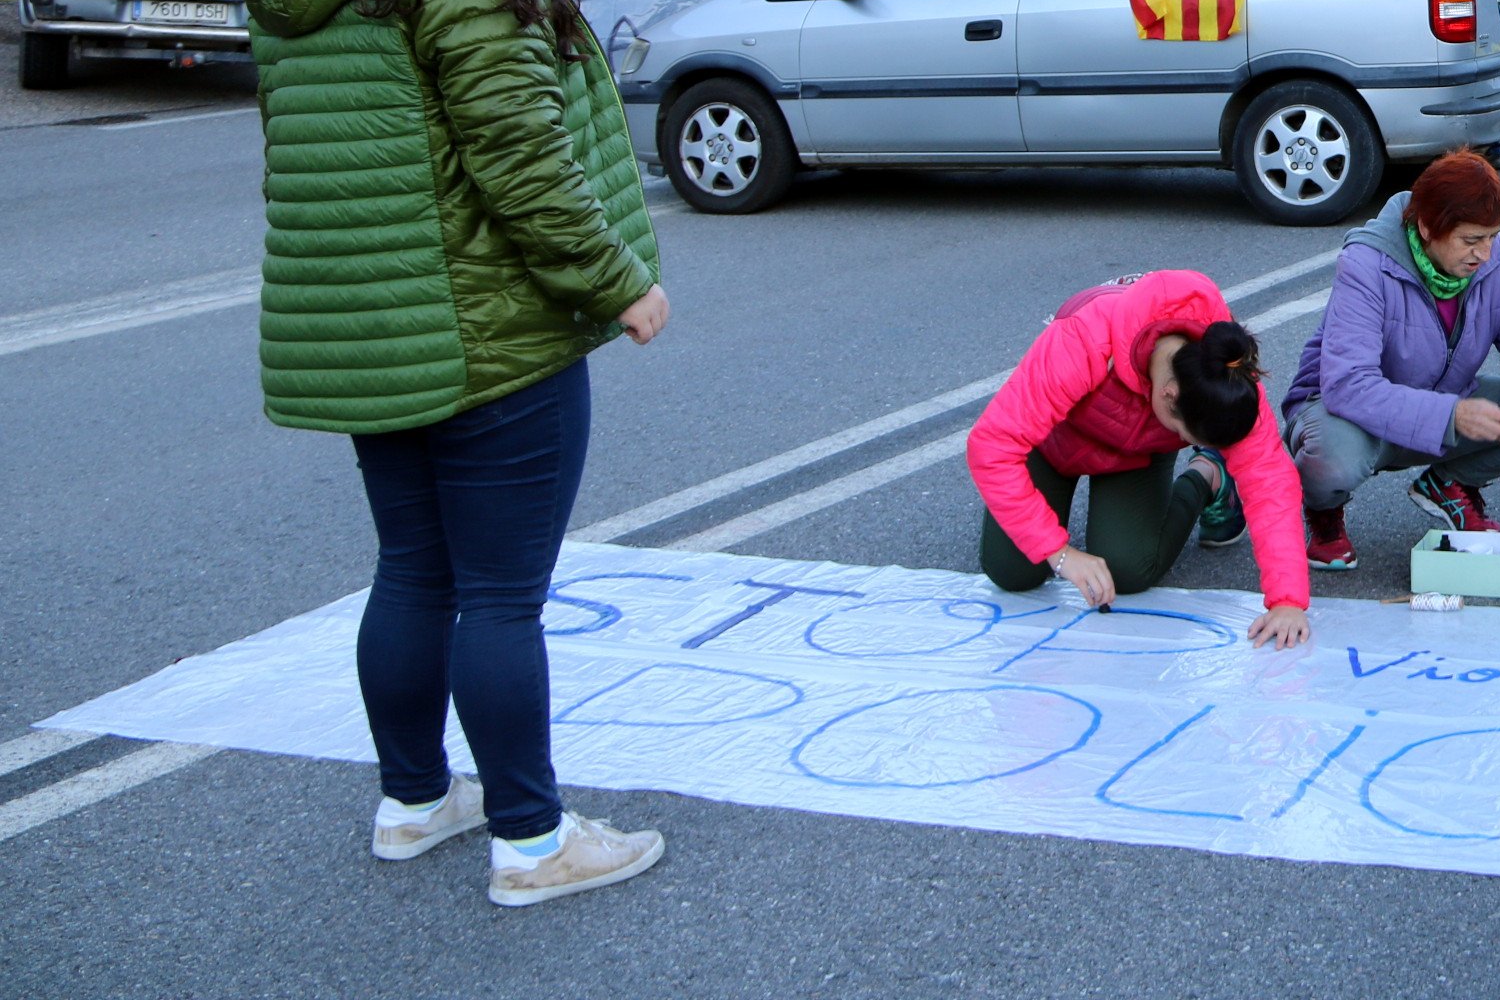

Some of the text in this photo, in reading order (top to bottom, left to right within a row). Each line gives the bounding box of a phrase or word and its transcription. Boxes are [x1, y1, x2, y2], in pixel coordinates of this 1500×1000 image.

[150, 2, 224, 19] 7601 DSH
[543, 571, 1238, 673] STOP
